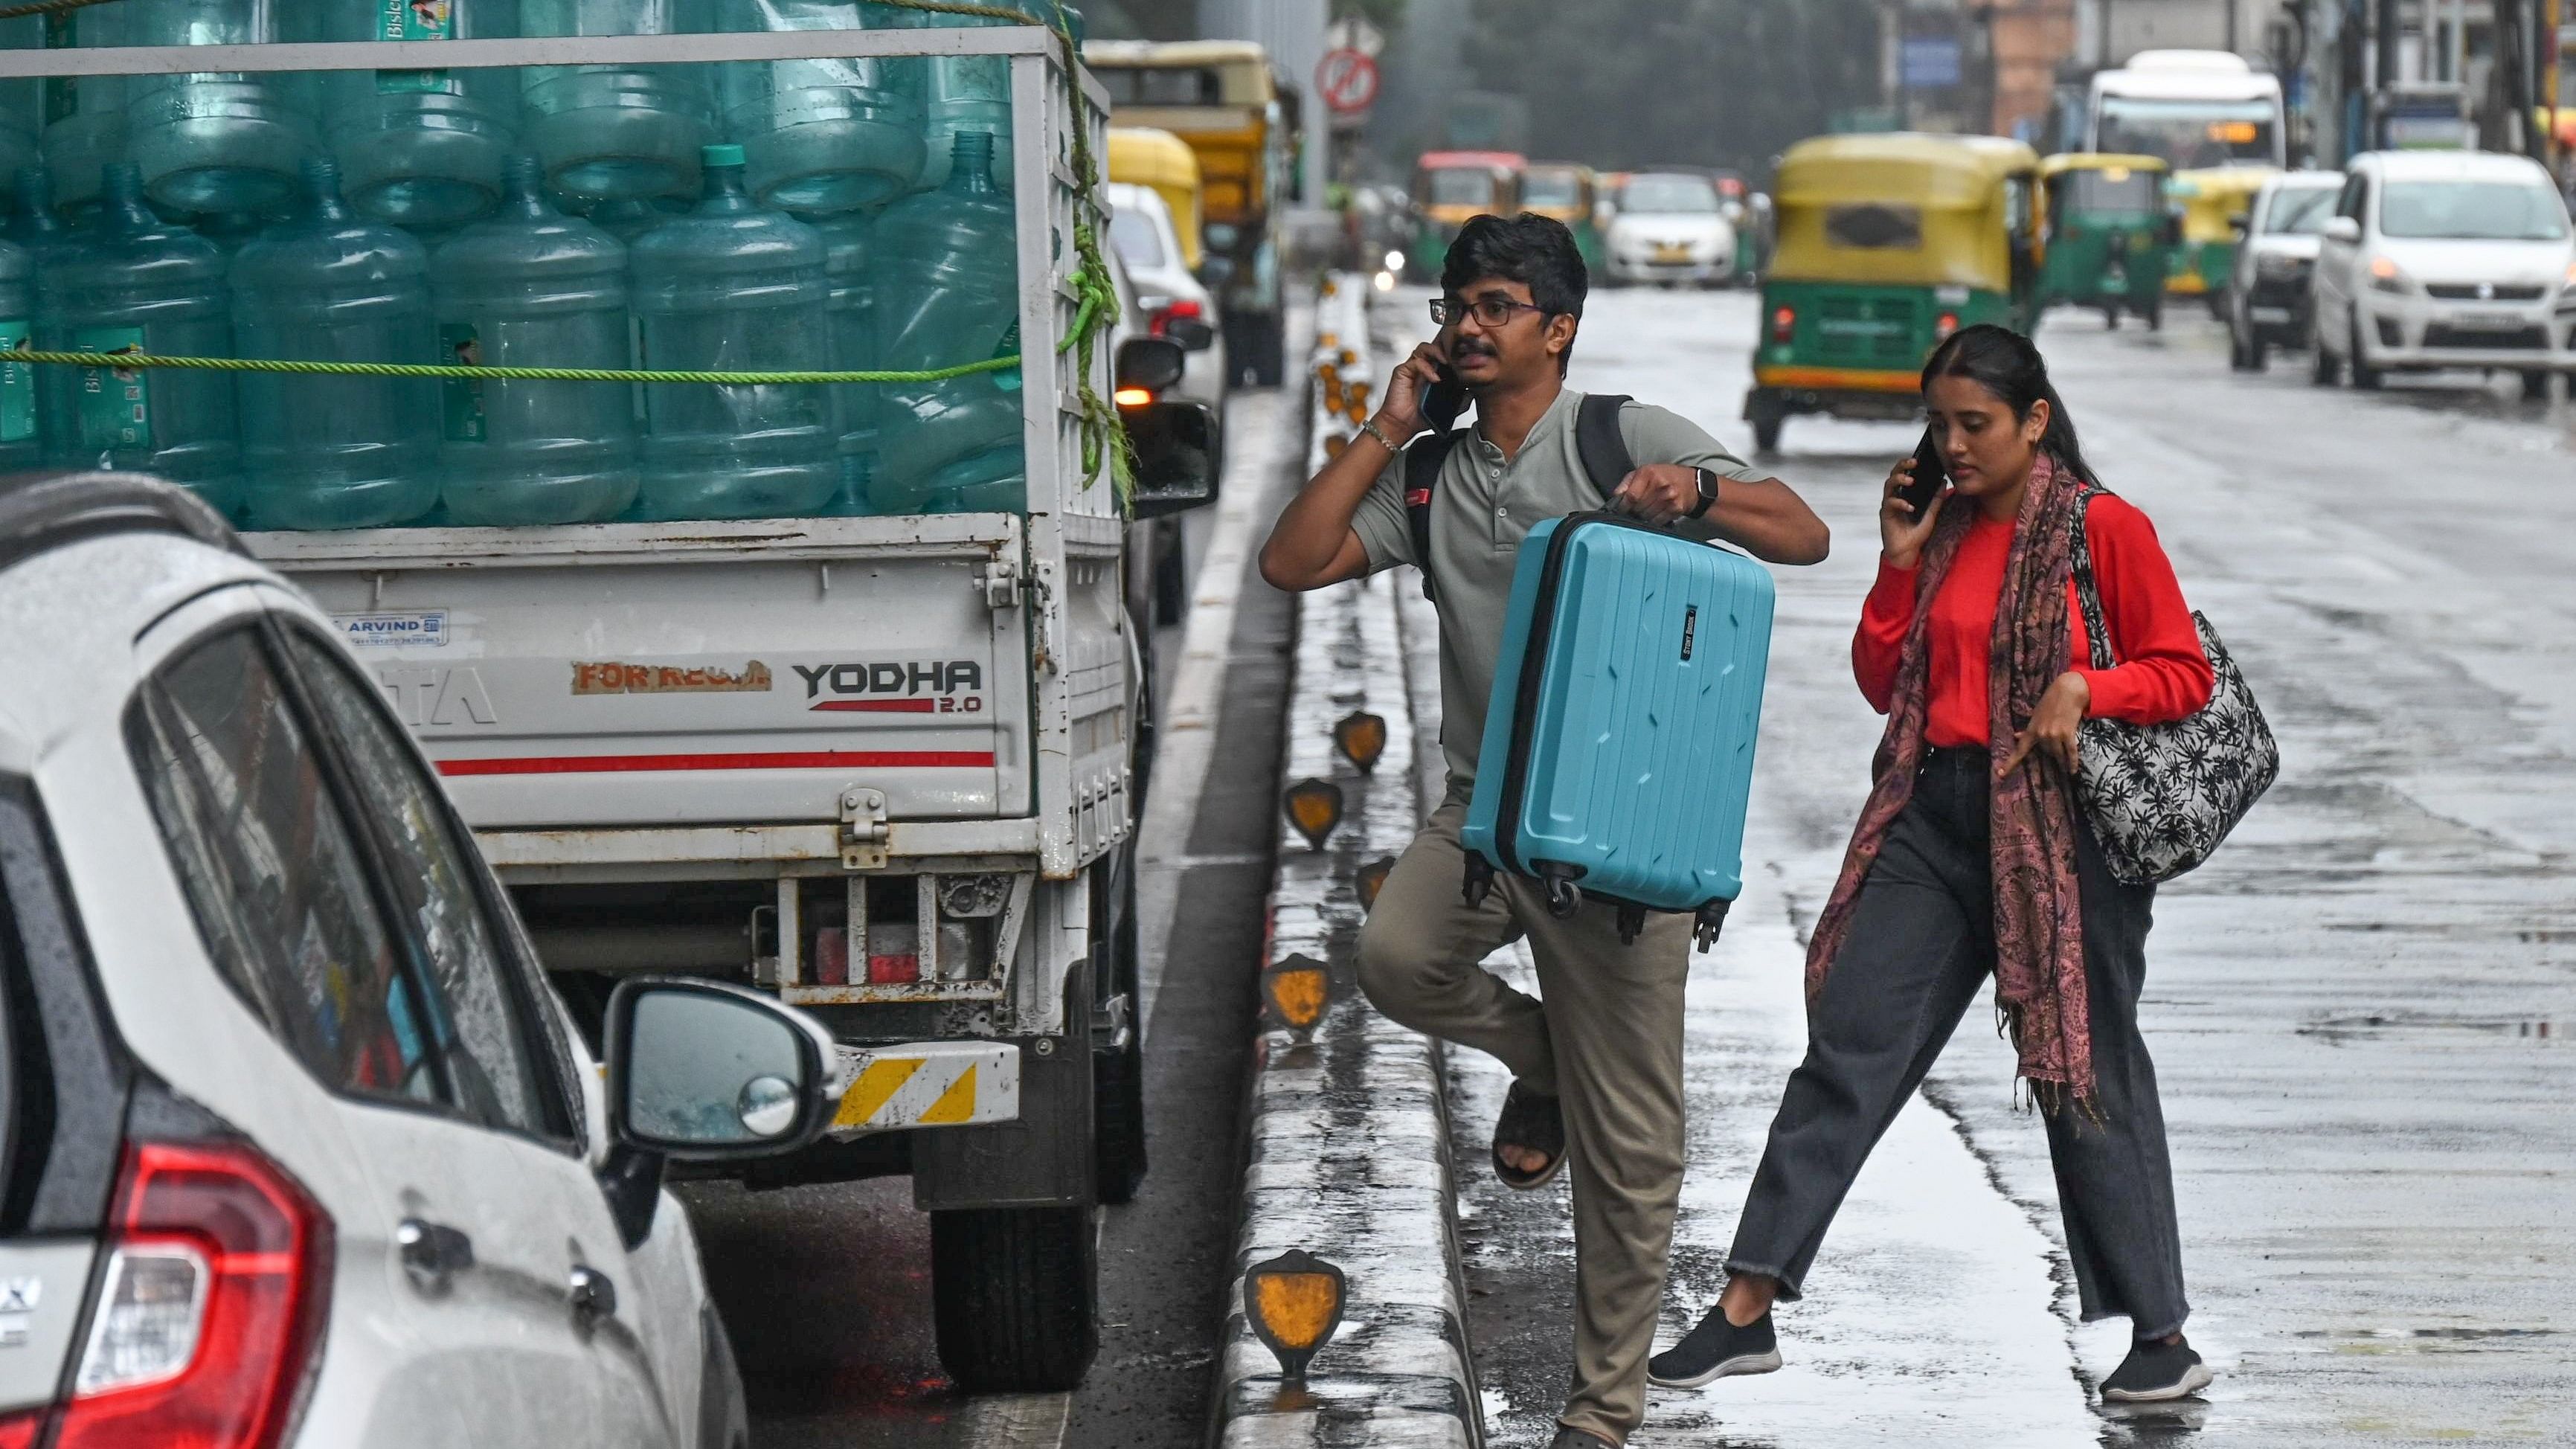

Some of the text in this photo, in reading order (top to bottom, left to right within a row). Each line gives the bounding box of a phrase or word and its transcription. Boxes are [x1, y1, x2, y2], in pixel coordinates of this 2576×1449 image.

[385, 0, 402, 37] Bisle
[349, 621, 420, 632] ARVIND
[579, 663, 648, 689] FOR
[791, 661, 981, 699] YODHA
[939, 696, 982, 713] 2.0
